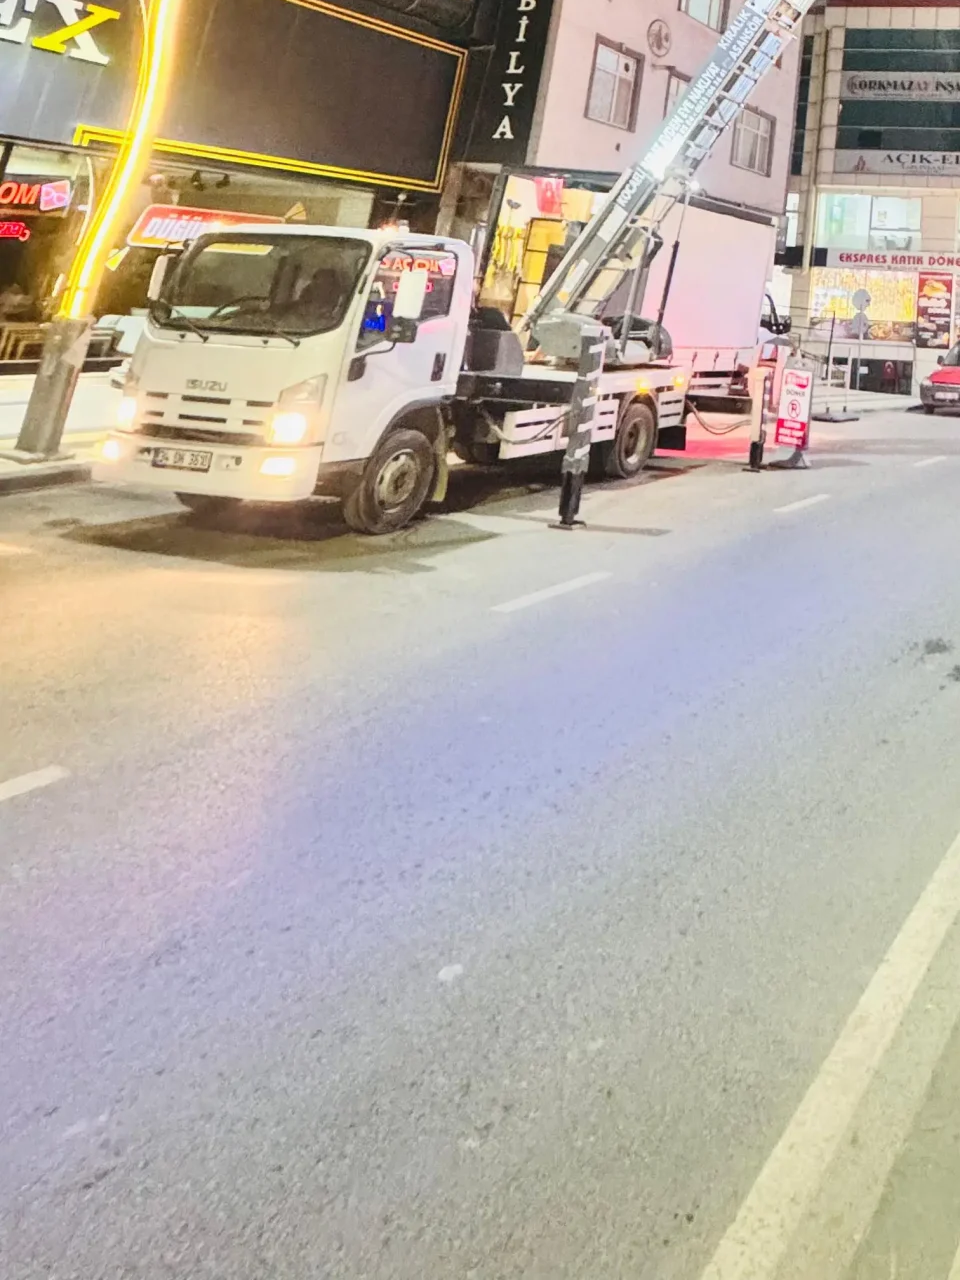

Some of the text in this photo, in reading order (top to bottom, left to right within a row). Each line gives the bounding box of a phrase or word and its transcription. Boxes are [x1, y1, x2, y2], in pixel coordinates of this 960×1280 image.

[839, 252, 887, 264] EKSPRES
[891, 254, 924, 265] KATIK
[186, 378, 228, 392] ISUZU
